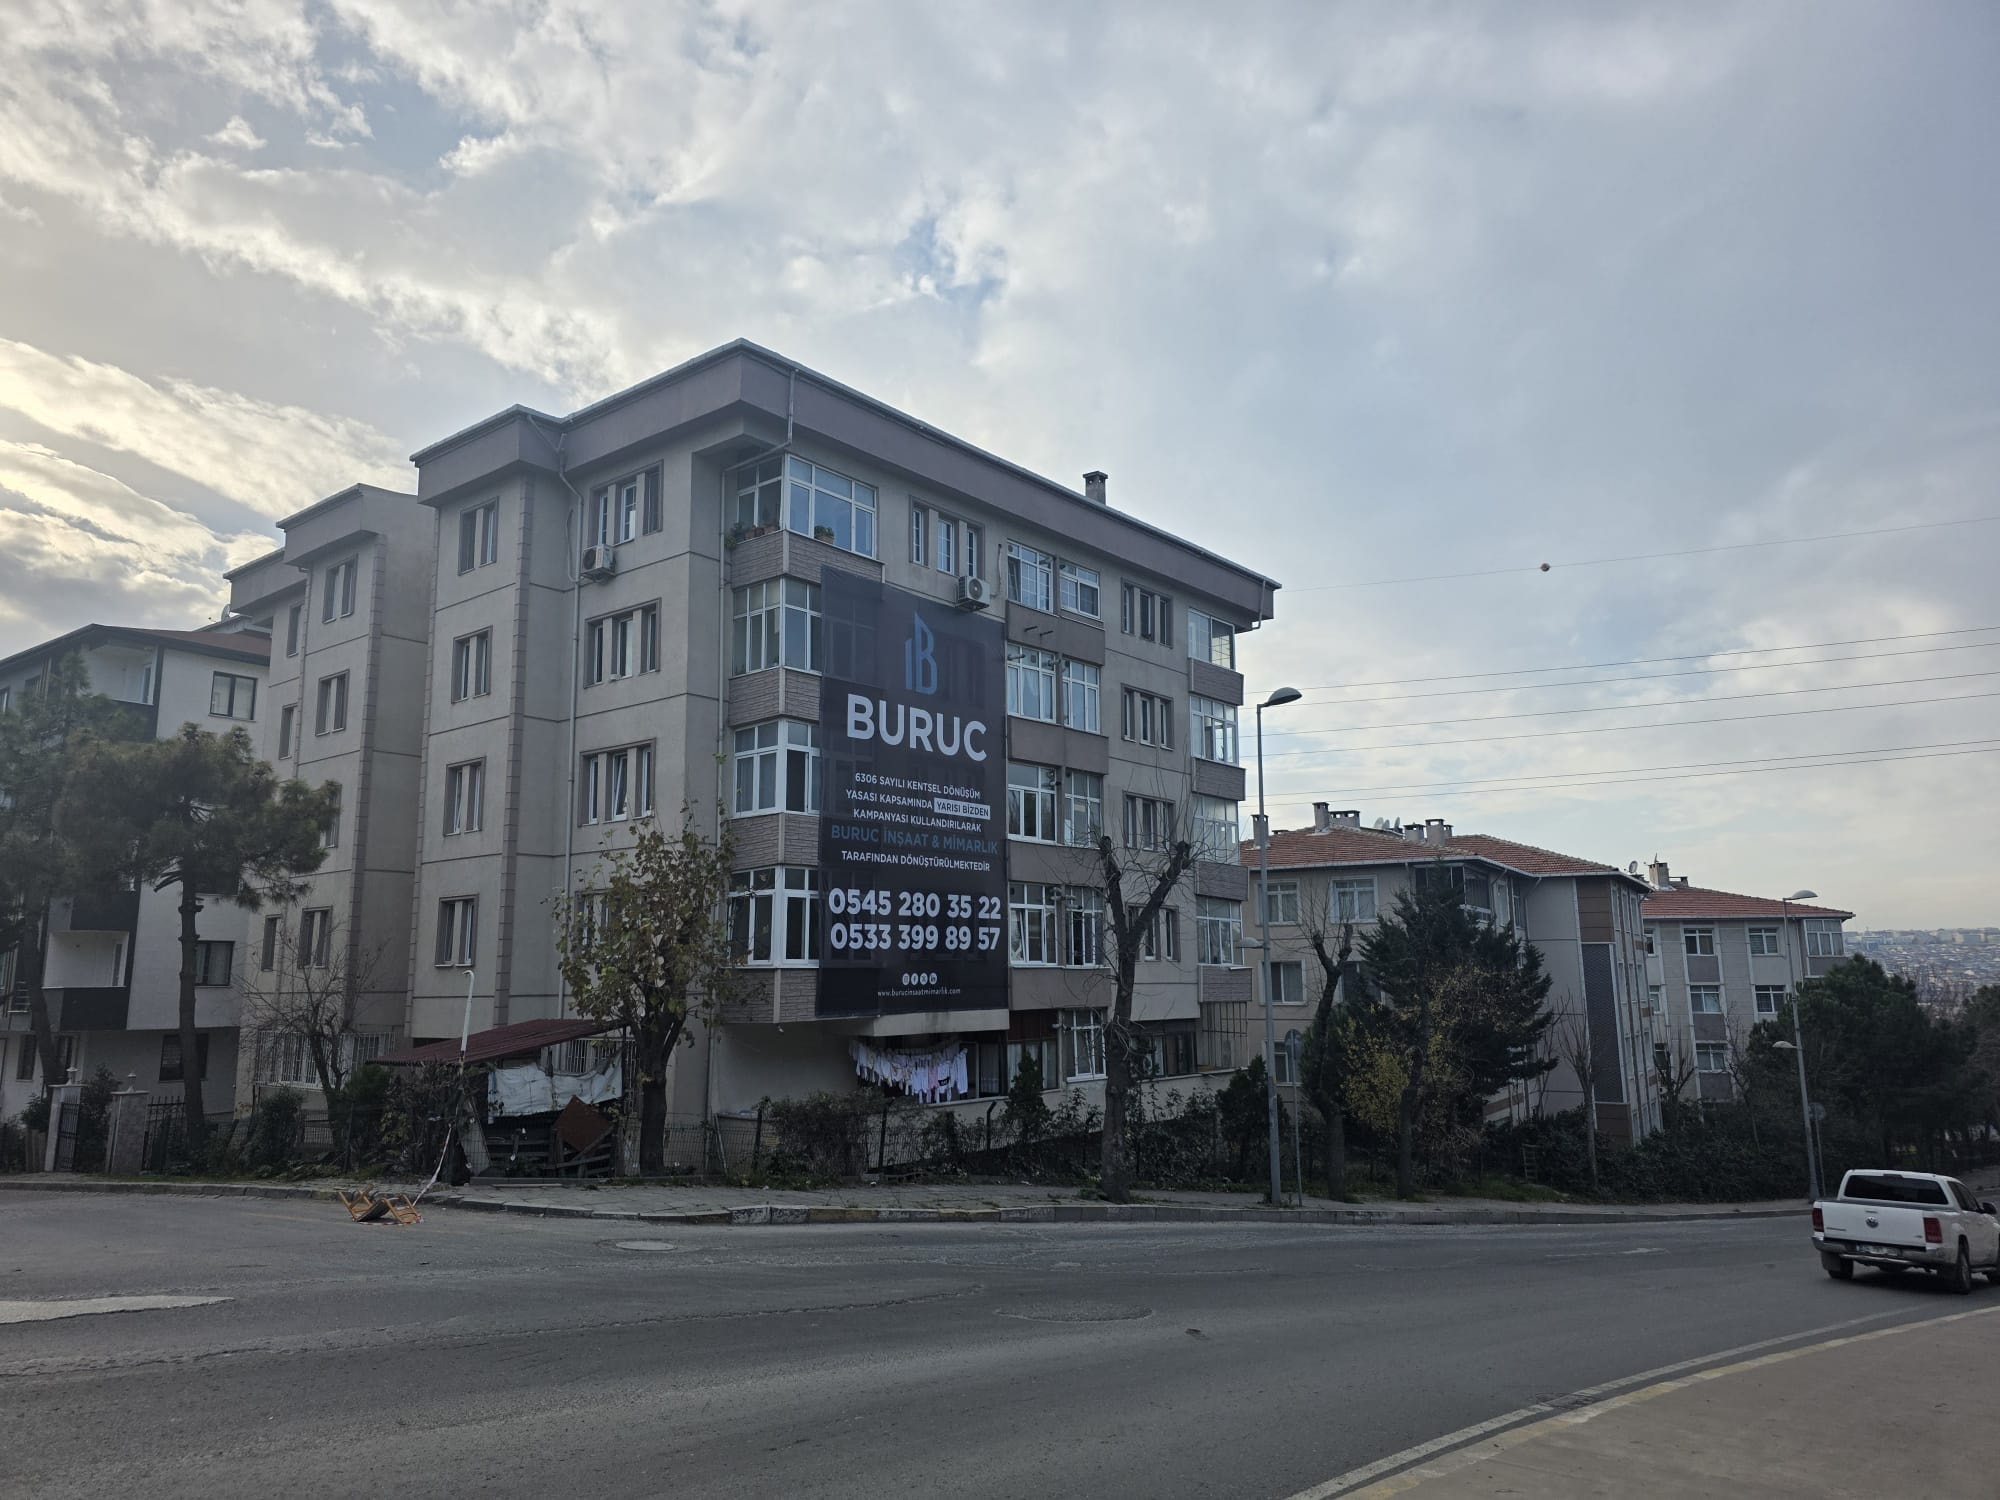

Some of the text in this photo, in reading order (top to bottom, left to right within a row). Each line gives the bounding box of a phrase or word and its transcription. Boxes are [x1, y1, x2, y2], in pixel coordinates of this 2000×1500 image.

[847, 693, 987, 761] BURUC
[855, 772, 980, 799] 6306 SAYILI KENTSEL DÖNÜŞÜM
[846, 789, 989, 817] YASASI KAPSAMINDA YARISI BİZDEN
[853, 808, 982, 831] KAMPANYASI KULLANDIRILARAK
[831, 825, 998, 855] BURUC İNŞAAT & MİMARLIK
[841, 850, 990, 872] TARAFINDAN DÖNÜŞTÜRÜLMEKTEDİR
[828, 888, 1001, 919] 0545 280 35 22
[830, 923, 1001, 950] 0533 399 89 57
